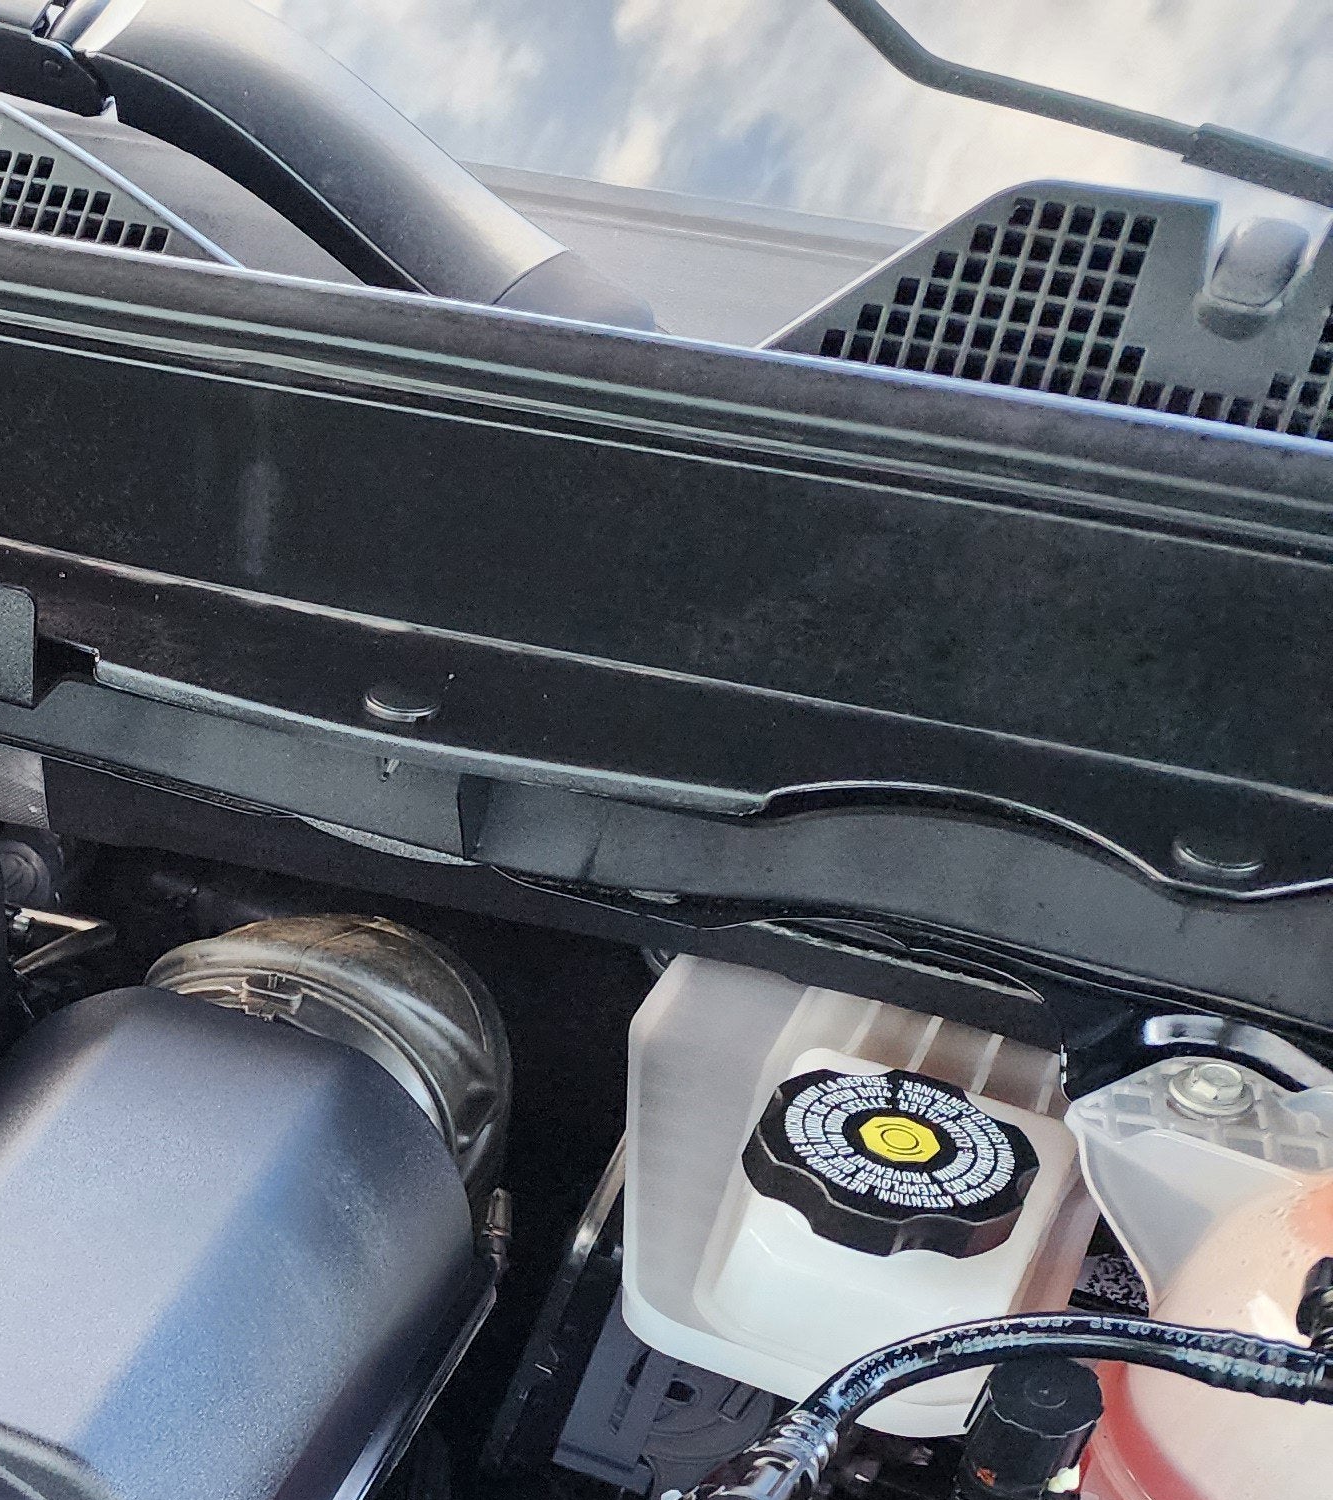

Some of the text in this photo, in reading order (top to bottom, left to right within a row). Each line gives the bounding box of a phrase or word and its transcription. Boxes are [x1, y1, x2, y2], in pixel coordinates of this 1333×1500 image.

[817, 1079, 841, 1092] LA
[855, 1086, 891, 1097] DOT4
[792, 1085, 823, 1108] AVANT
[821, 1088, 857, 1106] FREIN
[896, 1089, 931, 1105] ONLY
[899, 1080, 978, 1114] CONTAINER.
[809, 1101, 830, 1114] DE
[898, 1099, 946, 1123] FILLER
[930, 1100, 958, 1117] USE
[940, 1120, 972, 1147] CLEAN
[970, 1112, 1008, 1143] SEALED
[793, 1144, 816, 1156] LE
[813, 1143, 836, 1156] DU
[827, 1155, 856, 1173] QUE
[847, 1154, 930, 1183] PROVENANT
[806, 1155, 868, 1193] NETTOYER
[942, 1178, 967, 1193] CAP
